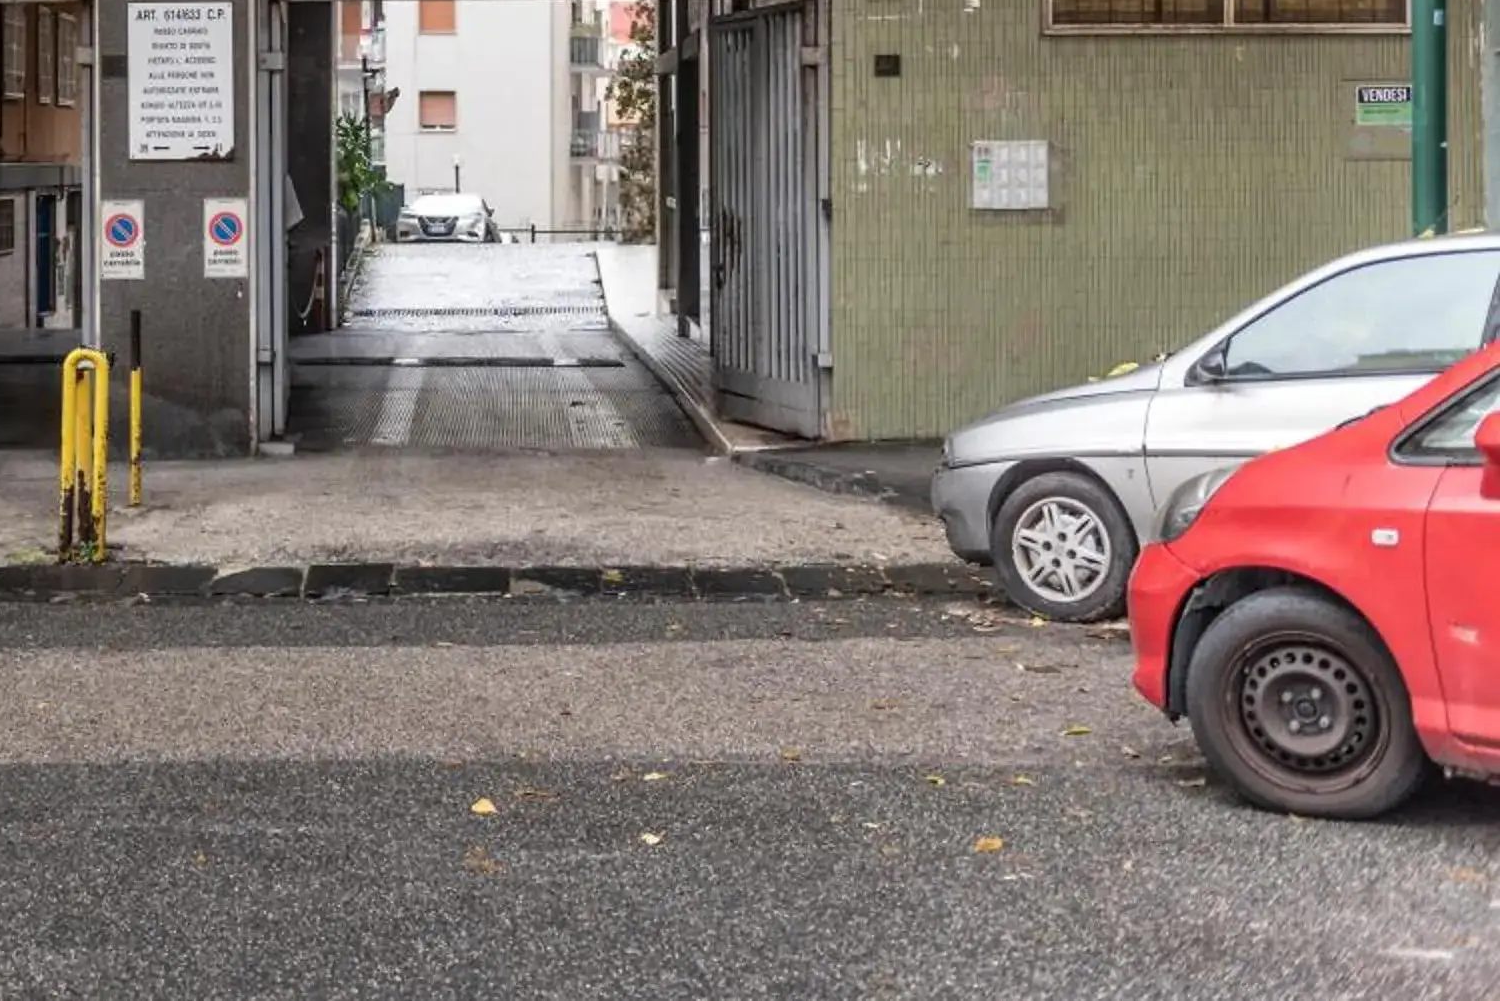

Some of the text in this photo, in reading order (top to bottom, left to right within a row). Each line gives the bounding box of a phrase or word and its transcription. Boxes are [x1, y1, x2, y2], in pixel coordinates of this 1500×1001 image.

[135, 9, 158, 21] ART.
[207, 8, 227, 20] C.P.
[1361, 88, 1407, 102] VENDESI
